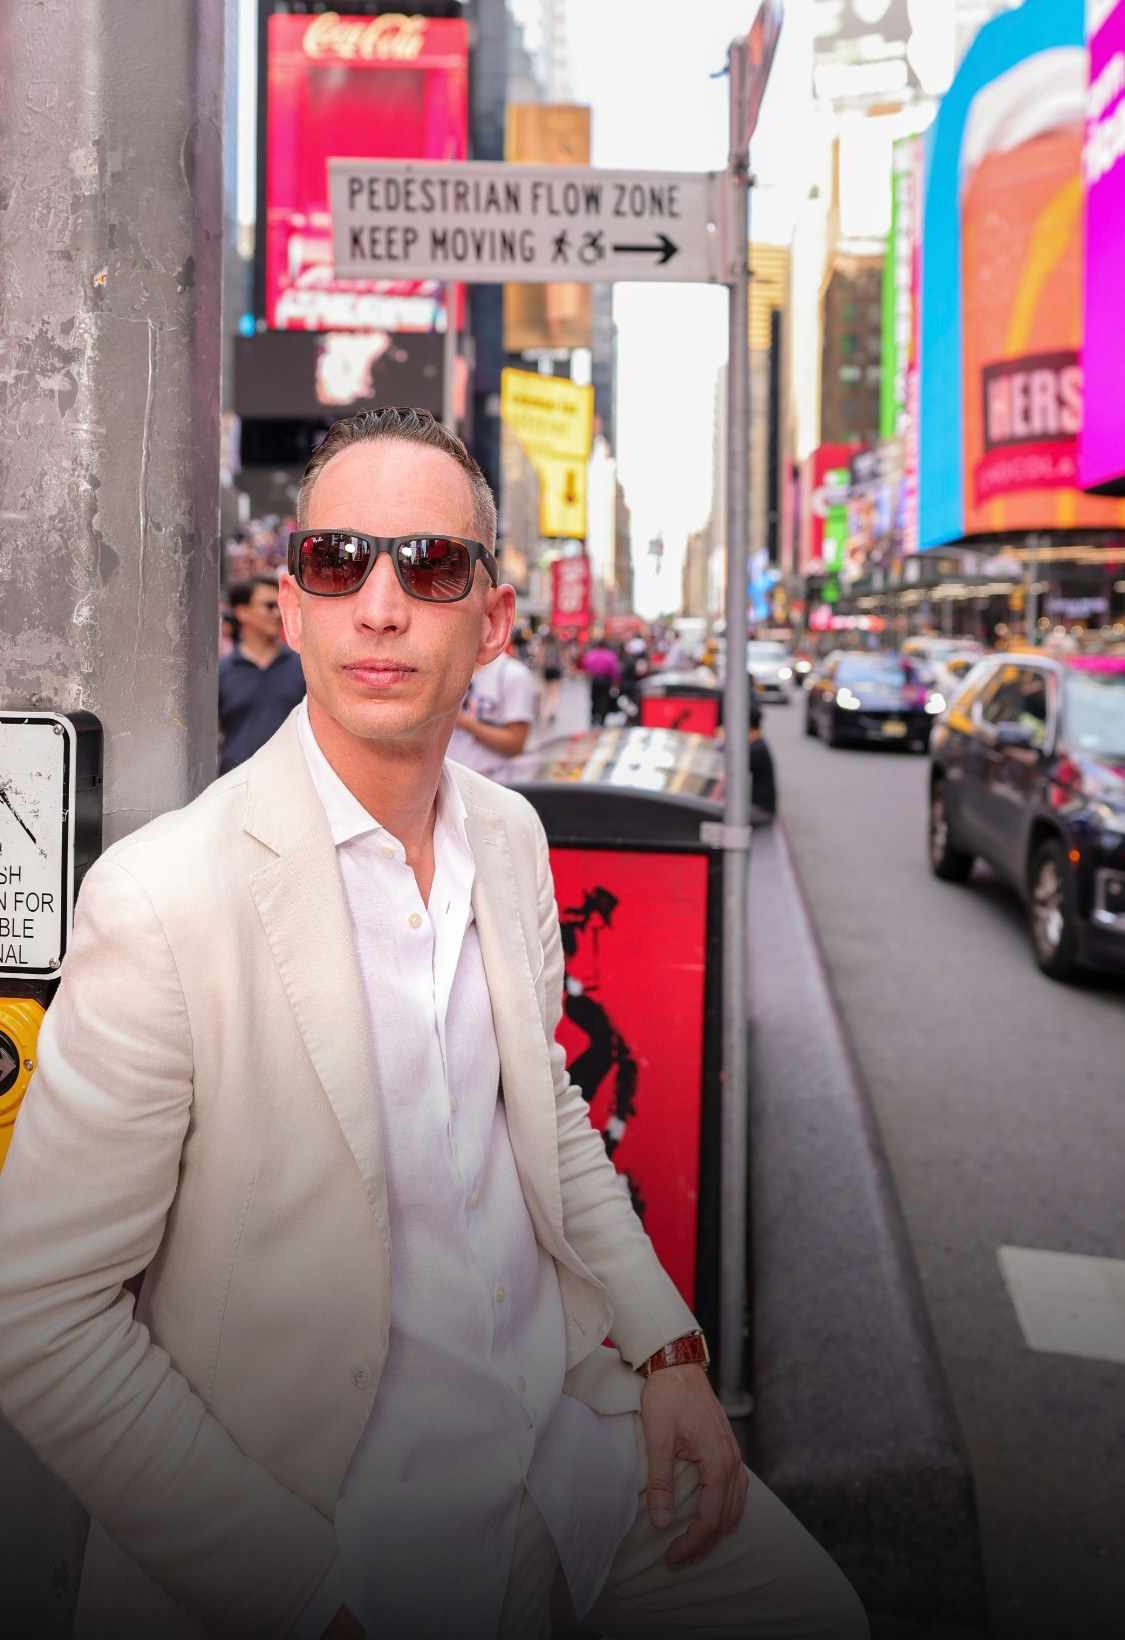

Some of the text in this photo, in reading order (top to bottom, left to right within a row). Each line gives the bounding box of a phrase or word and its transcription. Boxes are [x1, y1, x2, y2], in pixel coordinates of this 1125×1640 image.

[348, 176, 680, 218] PEDESTRIAN FLOW ZONE
[350, 226, 418, 260] KEEP
[430, 227, 535, 263] MOVING
[14, 891, 54, 912] FOR
[0, 917, 34, 938] BLE
